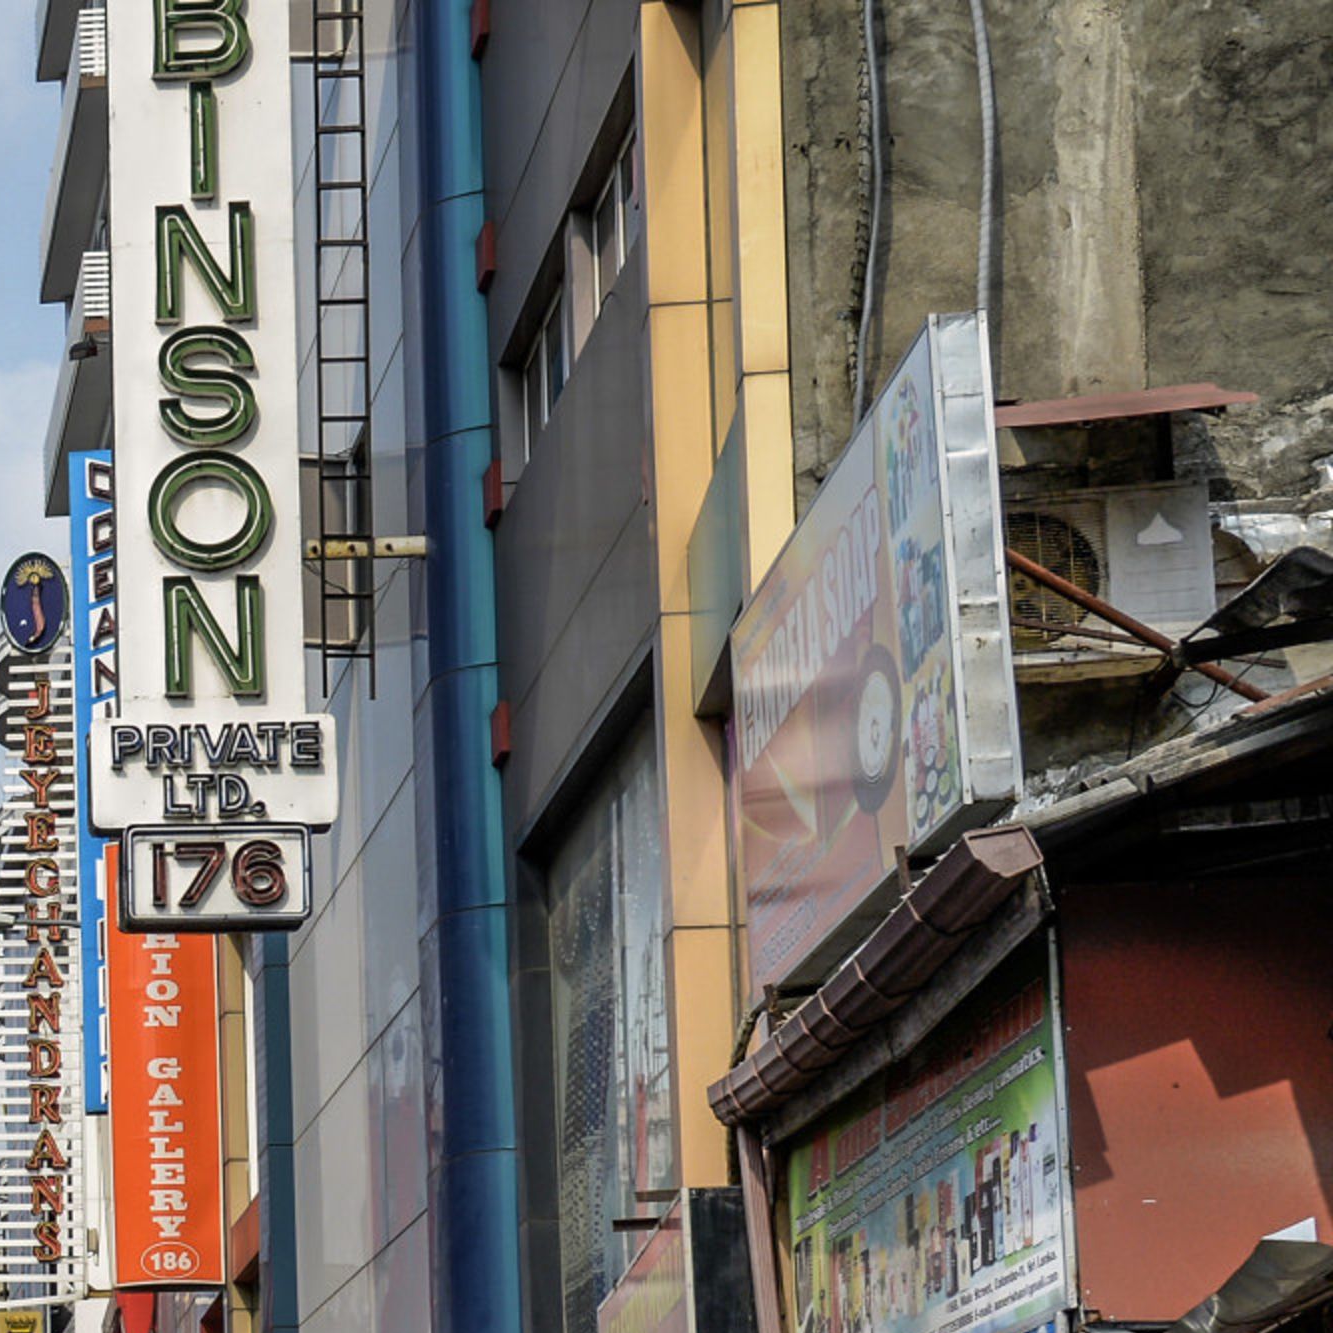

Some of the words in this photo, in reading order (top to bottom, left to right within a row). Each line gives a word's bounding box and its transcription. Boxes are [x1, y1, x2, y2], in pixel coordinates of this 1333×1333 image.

[147, 0, 273, 699] BINSON
[742, 577, 825, 772] CANDELA
[824, 482, 883, 656] SOAP
[110, 721, 323, 771] PRIVATE
[162, 772, 267, 821] LTD.
[152, 840, 285, 909] 176
[24, 680, 67, 1265] JEYECHANDRANS
[147, 1056, 188, 1239] GALLERY
[149, 1250, 193, 1273] 186
